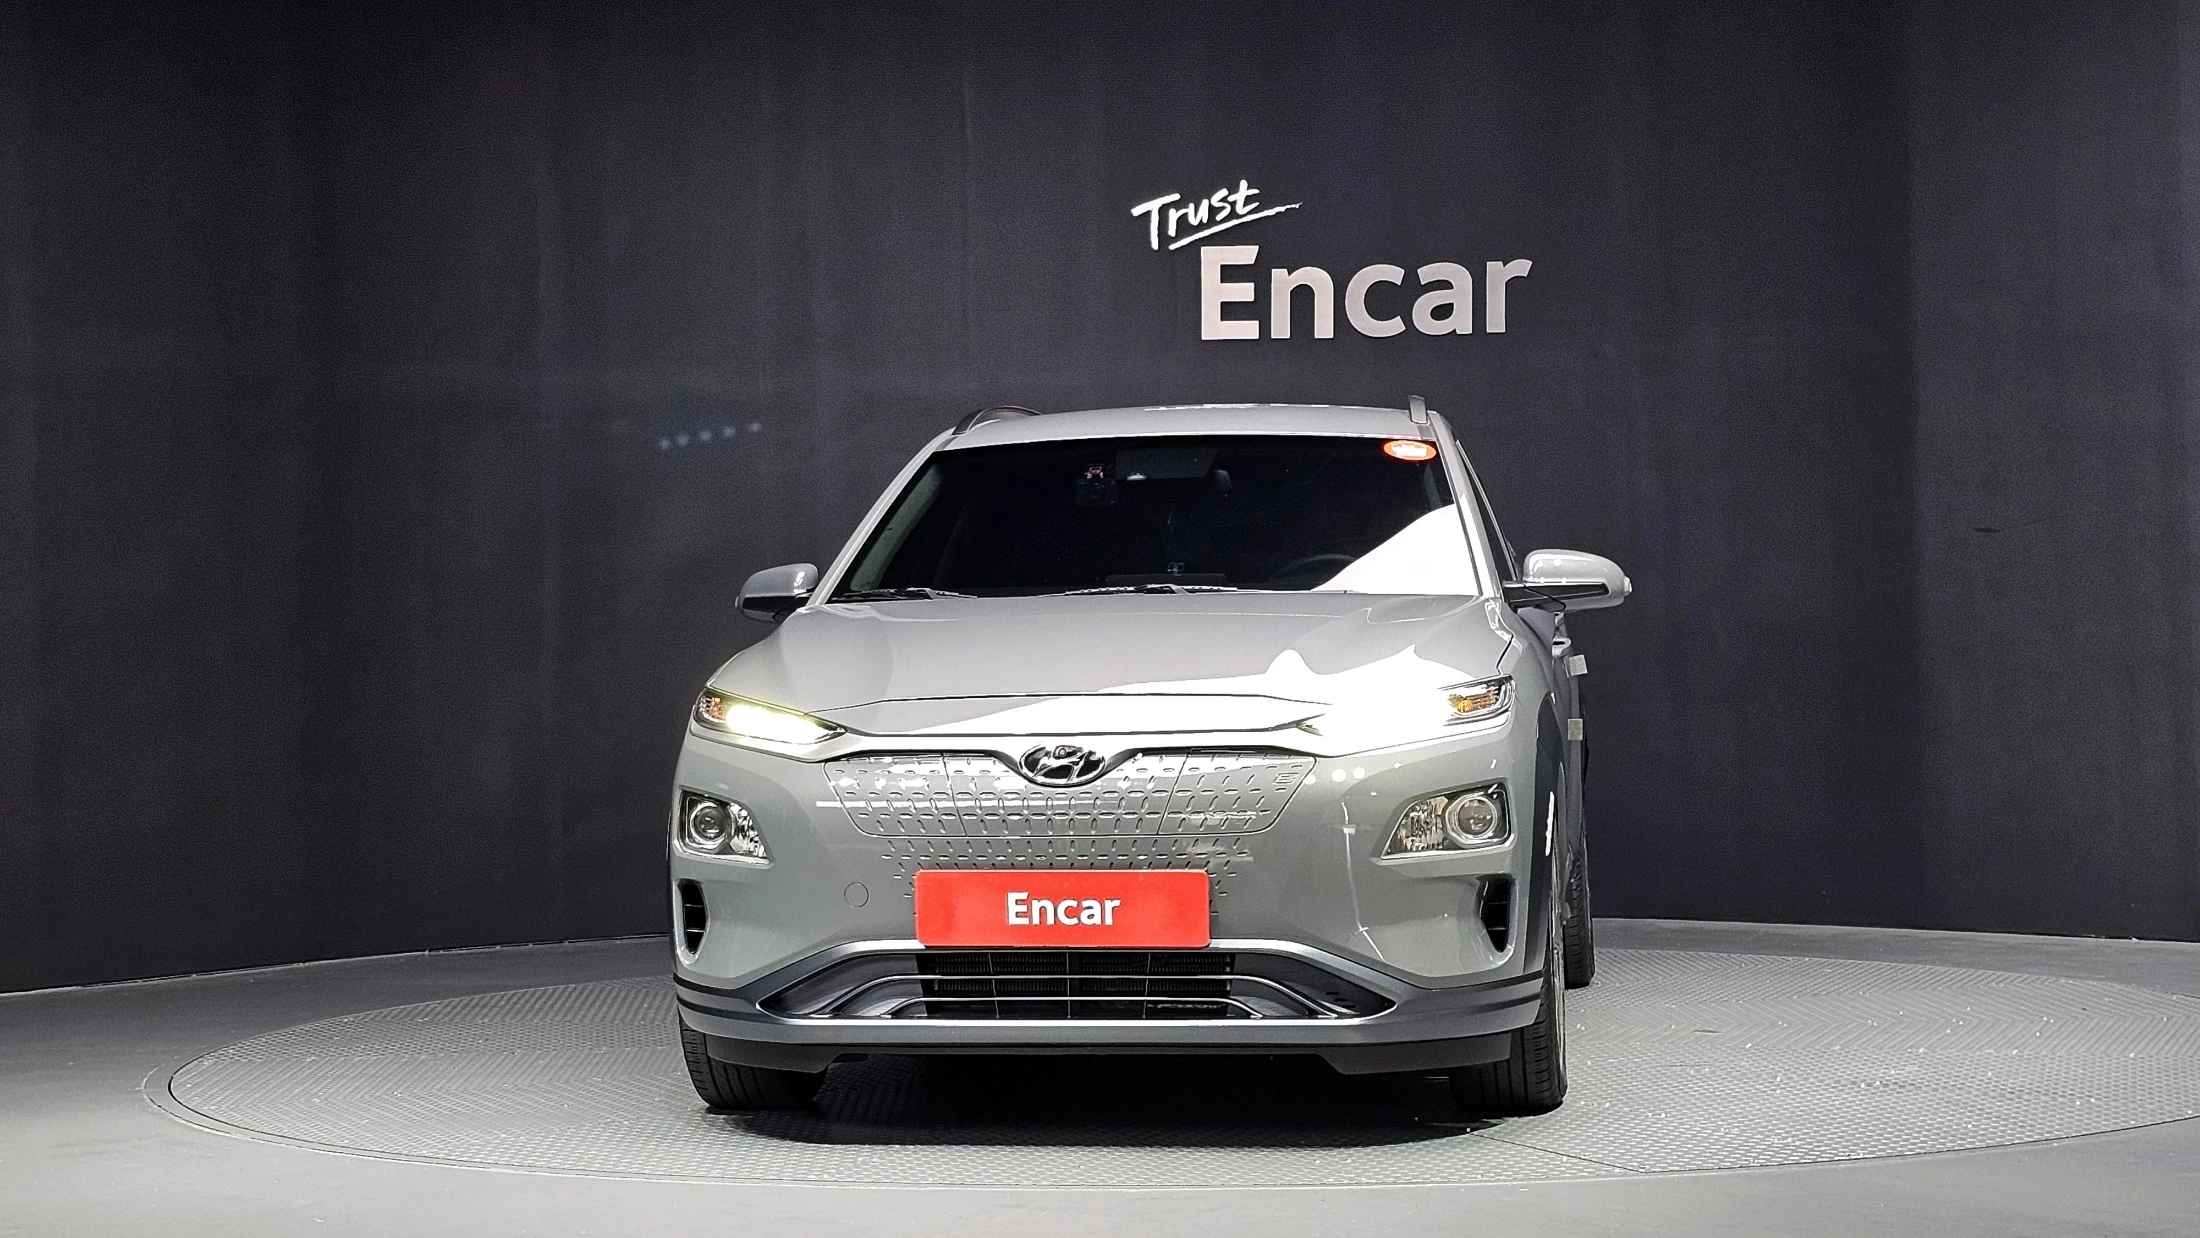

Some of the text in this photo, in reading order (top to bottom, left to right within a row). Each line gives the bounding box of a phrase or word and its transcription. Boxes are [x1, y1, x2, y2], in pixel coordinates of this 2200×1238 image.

[1131, 180, 1261, 250] Trust
[1200, 245, 1532, 340] Encar
[1006, 891, 1121, 926] Encar
